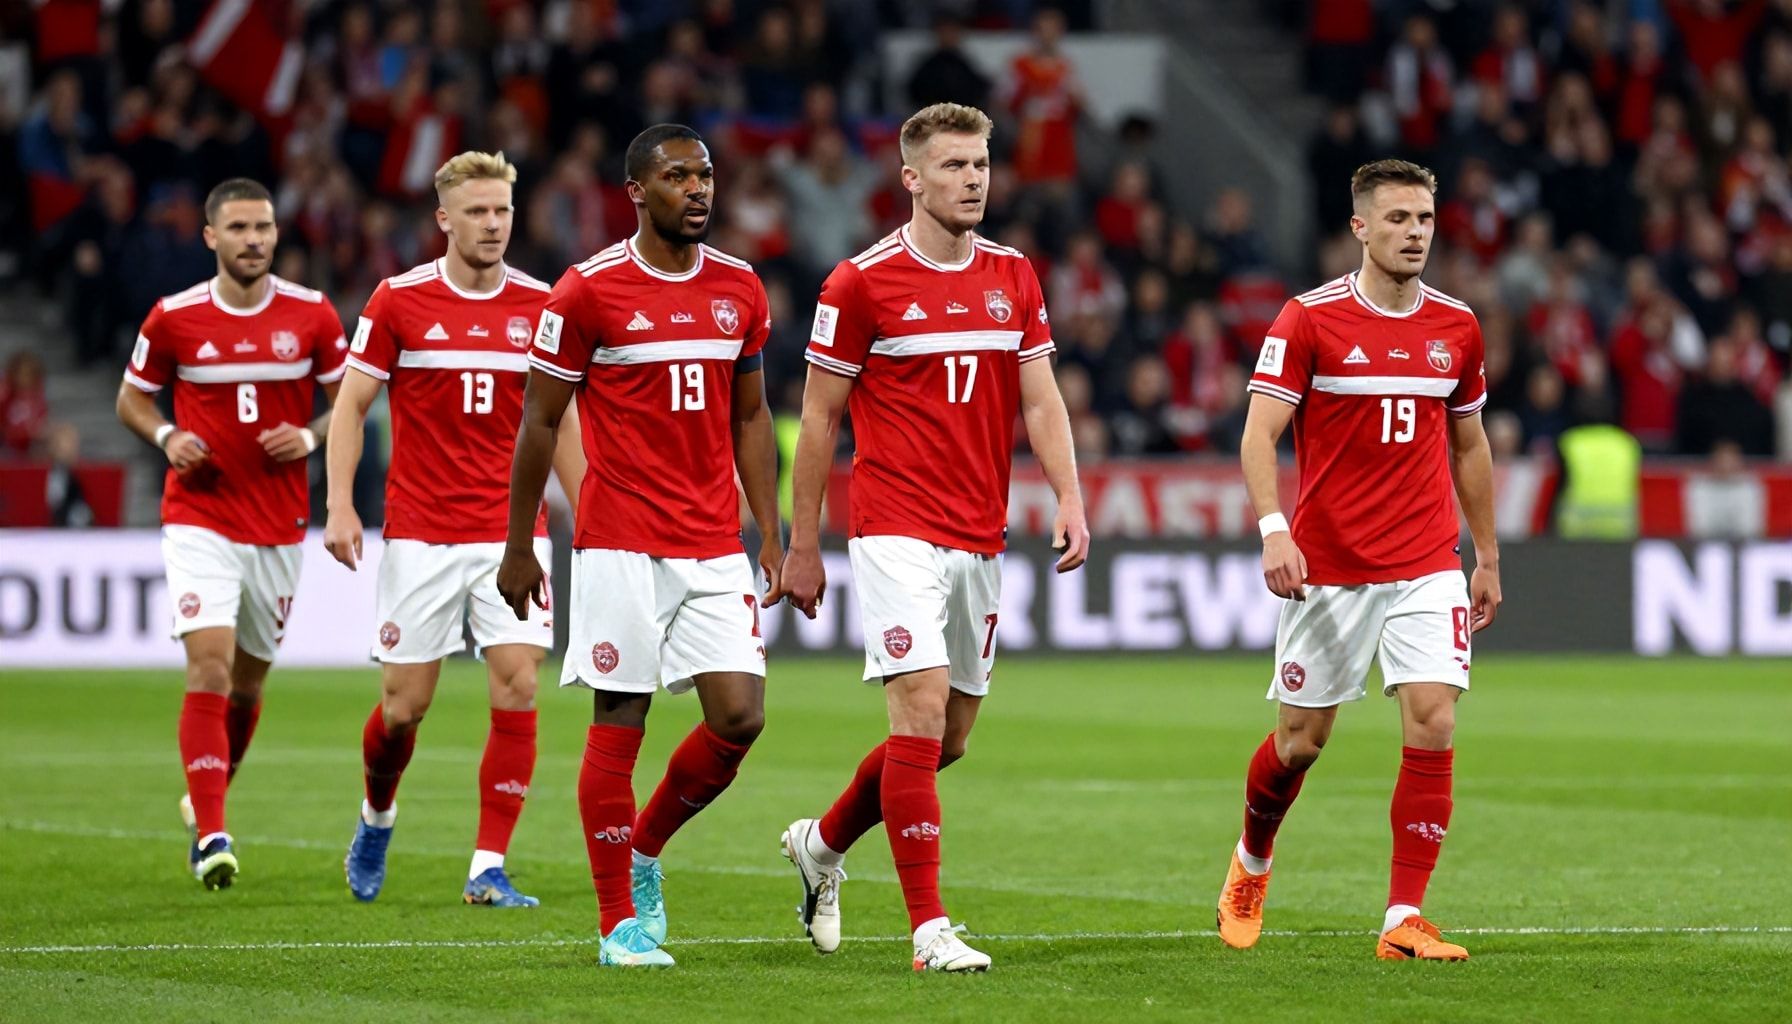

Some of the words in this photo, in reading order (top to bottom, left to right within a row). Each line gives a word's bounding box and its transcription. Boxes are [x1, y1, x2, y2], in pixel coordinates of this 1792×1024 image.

[460, 372, 495, 414] 13
[669, 363, 706, 412] 19
[944, 356, 978, 404] 17
[1380, 398, 1416, 443] 19
